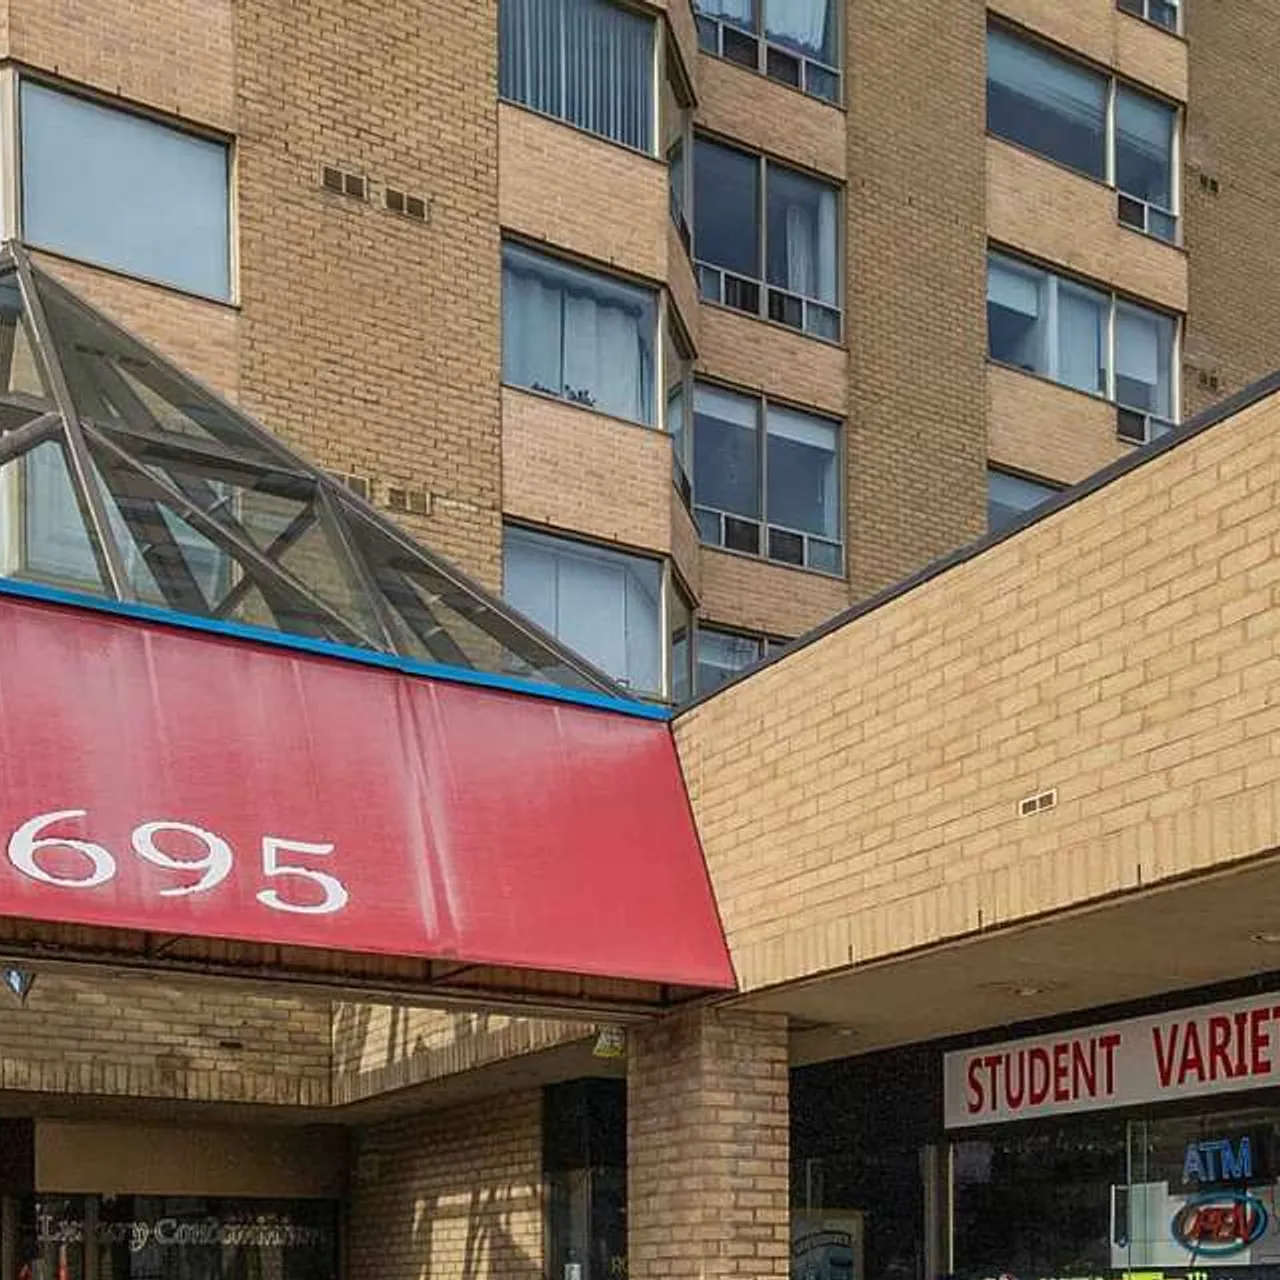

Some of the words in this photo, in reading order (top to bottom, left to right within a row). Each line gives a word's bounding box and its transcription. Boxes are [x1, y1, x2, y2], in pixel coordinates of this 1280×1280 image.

[7, 808, 351, 915] 695
[966, 1034, 1121, 1115] STUDENT
[1182, 1136, 1252, 1184] ATM
